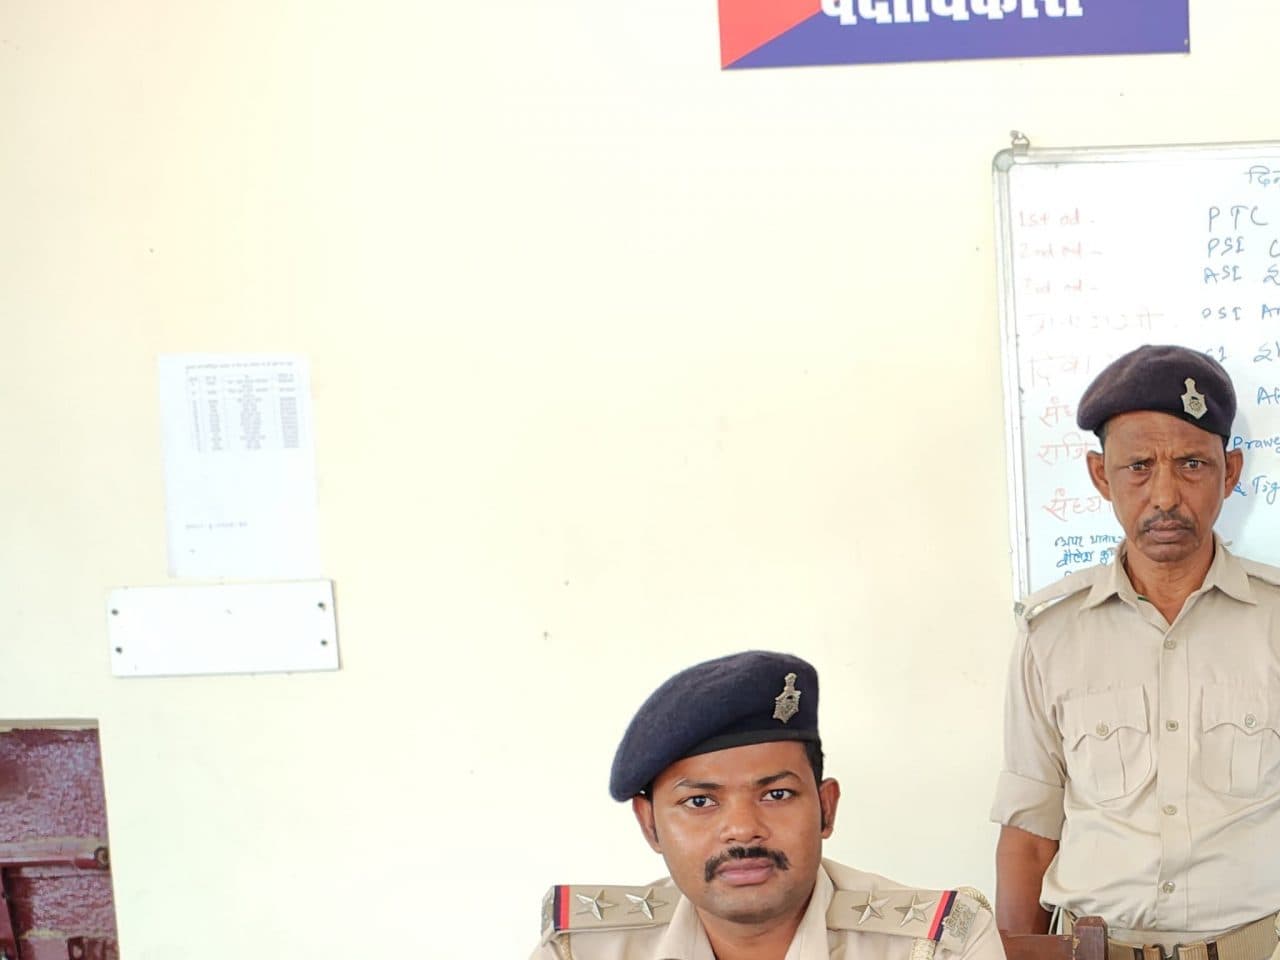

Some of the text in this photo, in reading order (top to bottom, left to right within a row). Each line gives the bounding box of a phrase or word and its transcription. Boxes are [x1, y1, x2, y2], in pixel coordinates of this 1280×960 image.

[1207, 204, 1269, 232] PTC
[1206, 236, 1246, 260] PSI
[1203, 265, 1243, 285] ASI
